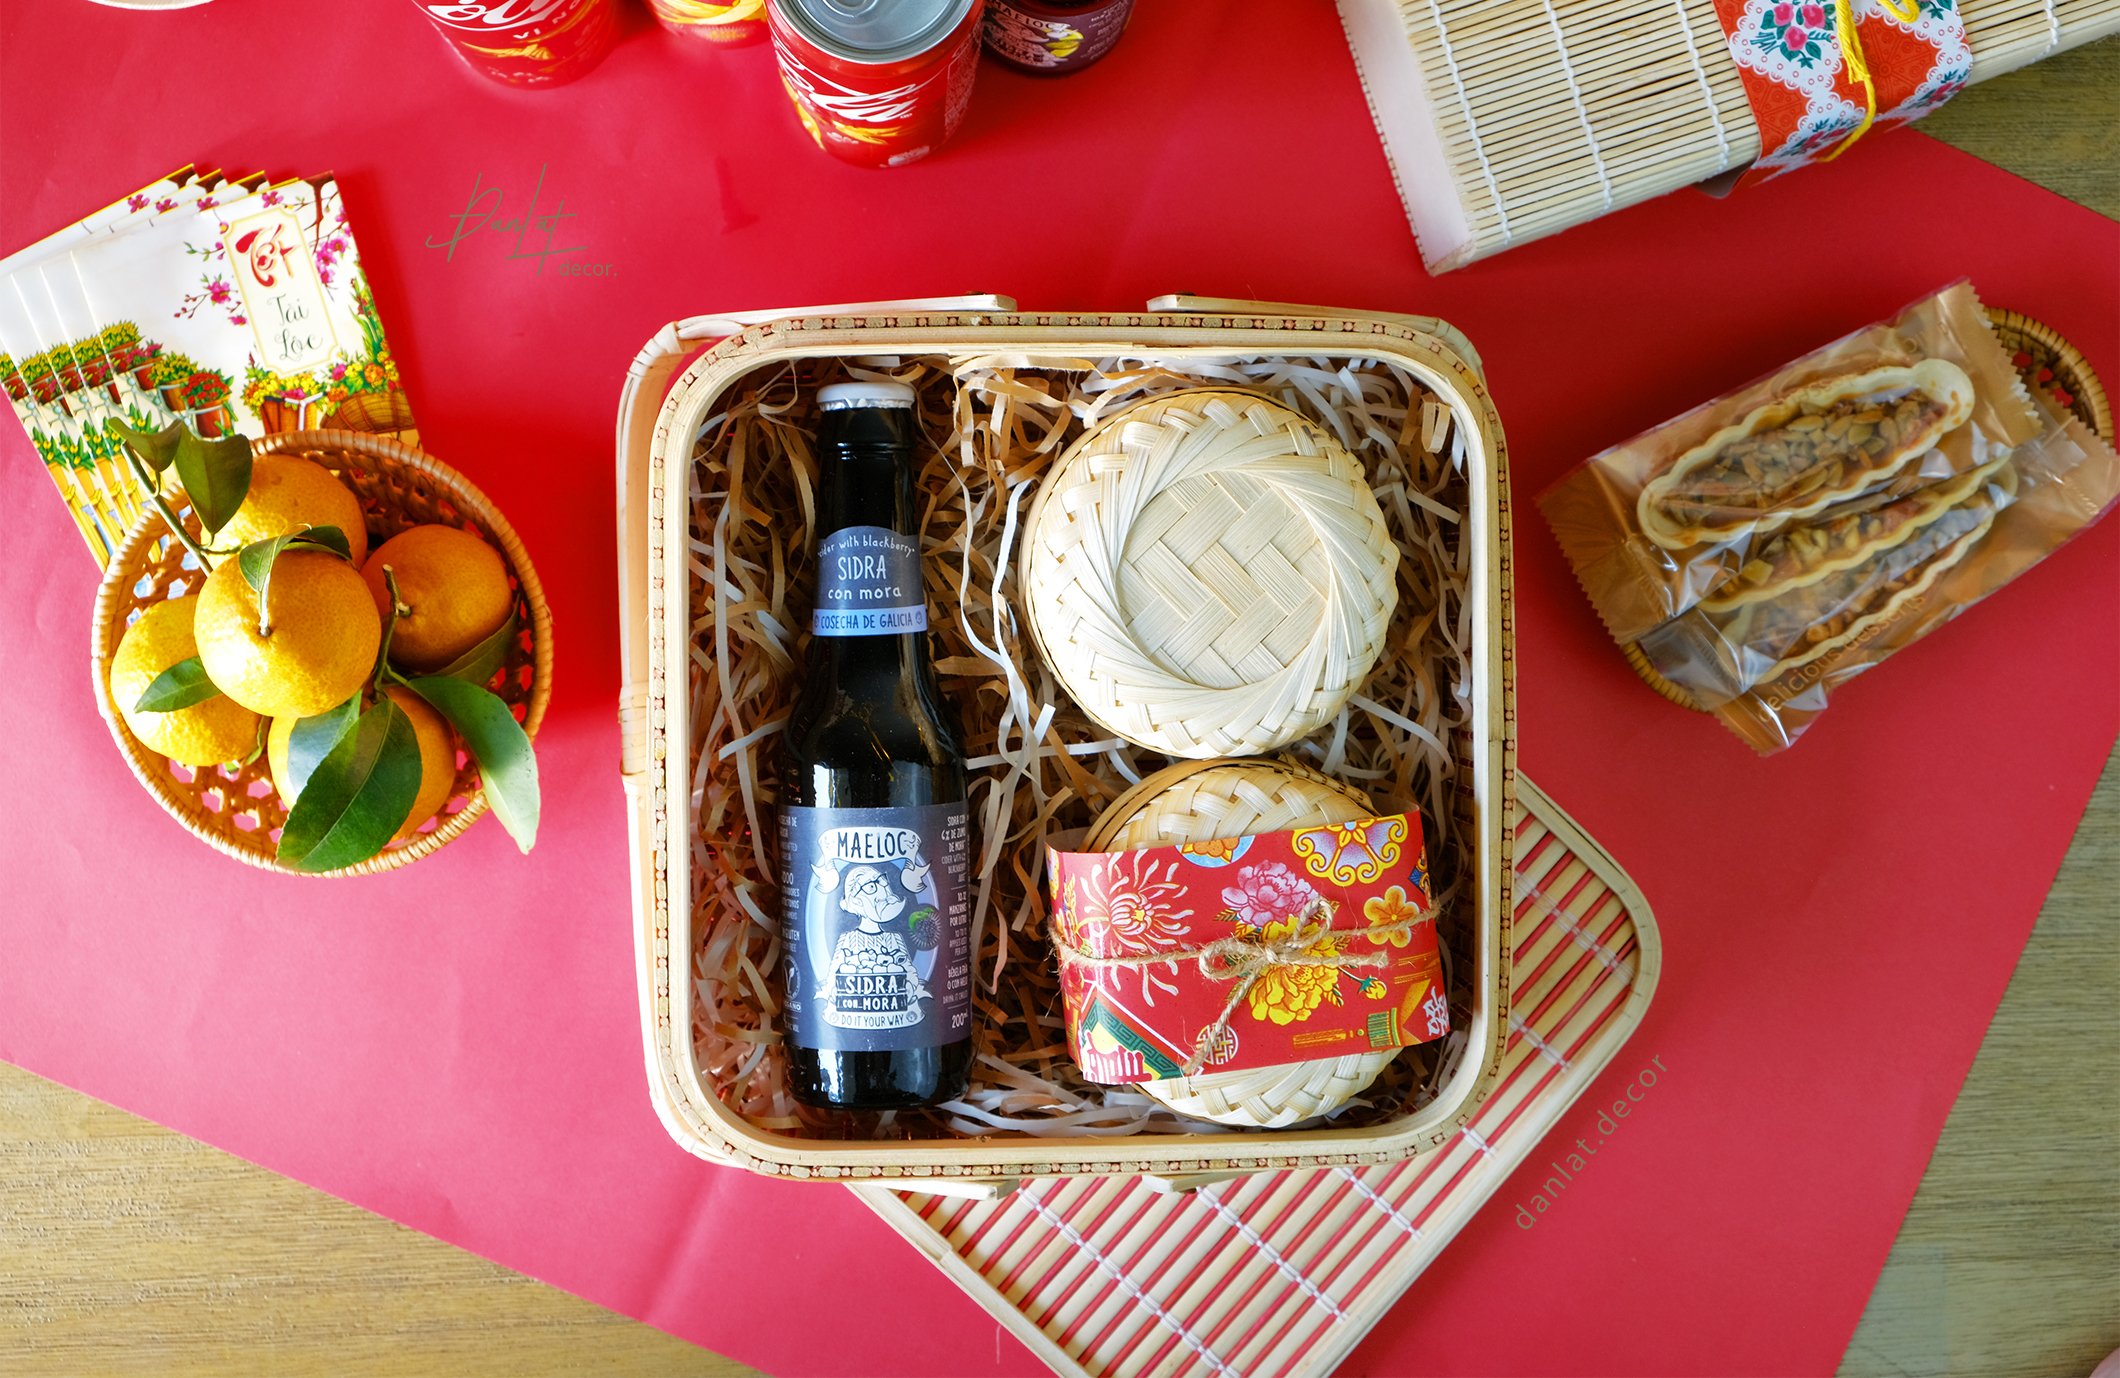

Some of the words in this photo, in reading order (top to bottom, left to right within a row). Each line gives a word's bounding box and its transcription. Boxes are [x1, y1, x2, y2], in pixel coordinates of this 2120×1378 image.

[266, 293, 309, 327] Tài
[838, 535, 860, 549] with
[837, 554, 887, 581] SIDRA
[827, 588, 852, 600] con
[859, 585, 902, 600] mora
[820, 613, 859, 630] COSECHA
[862, 614, 875, 629] DE
[879, 612, 913, 628] GALICIA
[1757, 648, 1843, 723] delicious
[836, 830, 908, 859] MAELOC
[845, 975, 898, 995] SIDRA
[862, 996, 899, 1011] MORA
[841, 1014, 853, 1026] DO
[854, 1015, 862, 1027] IT
[863, 1015, 887, 1028] YOUR
[886, 1013, 905, 1026] WAY
